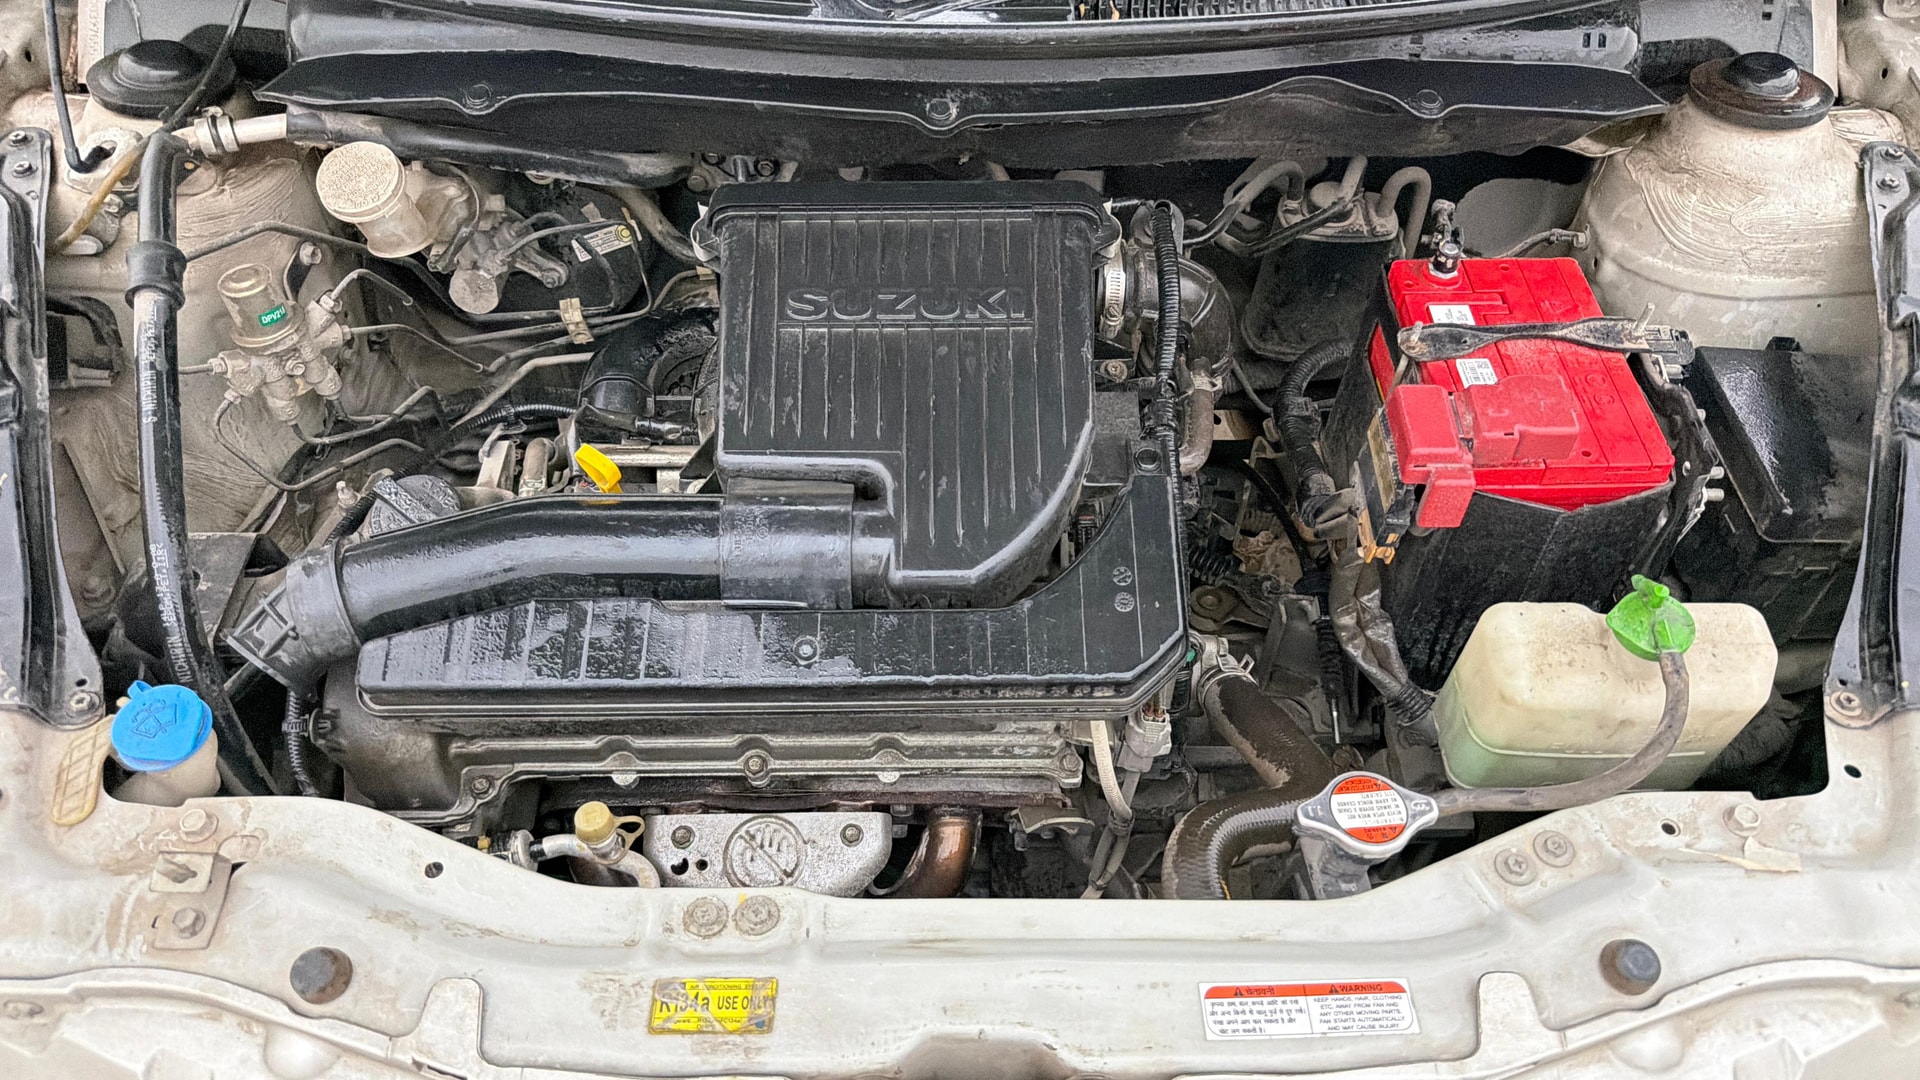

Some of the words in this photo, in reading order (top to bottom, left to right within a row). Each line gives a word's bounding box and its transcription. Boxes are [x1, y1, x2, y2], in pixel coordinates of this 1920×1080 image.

[787, 288, 1025, 320] SUZUKI
[142, 370, 158, 411] NICHIRIN
[166, 635, 193, 684] NICHIRIN
[1246, 985, 1275, 995] चेतावनी
[1340, 984, 1383, 992] WARNING
[718, 996, 738, 1010] USE
[742, 996, 769, 1010] ONLY
